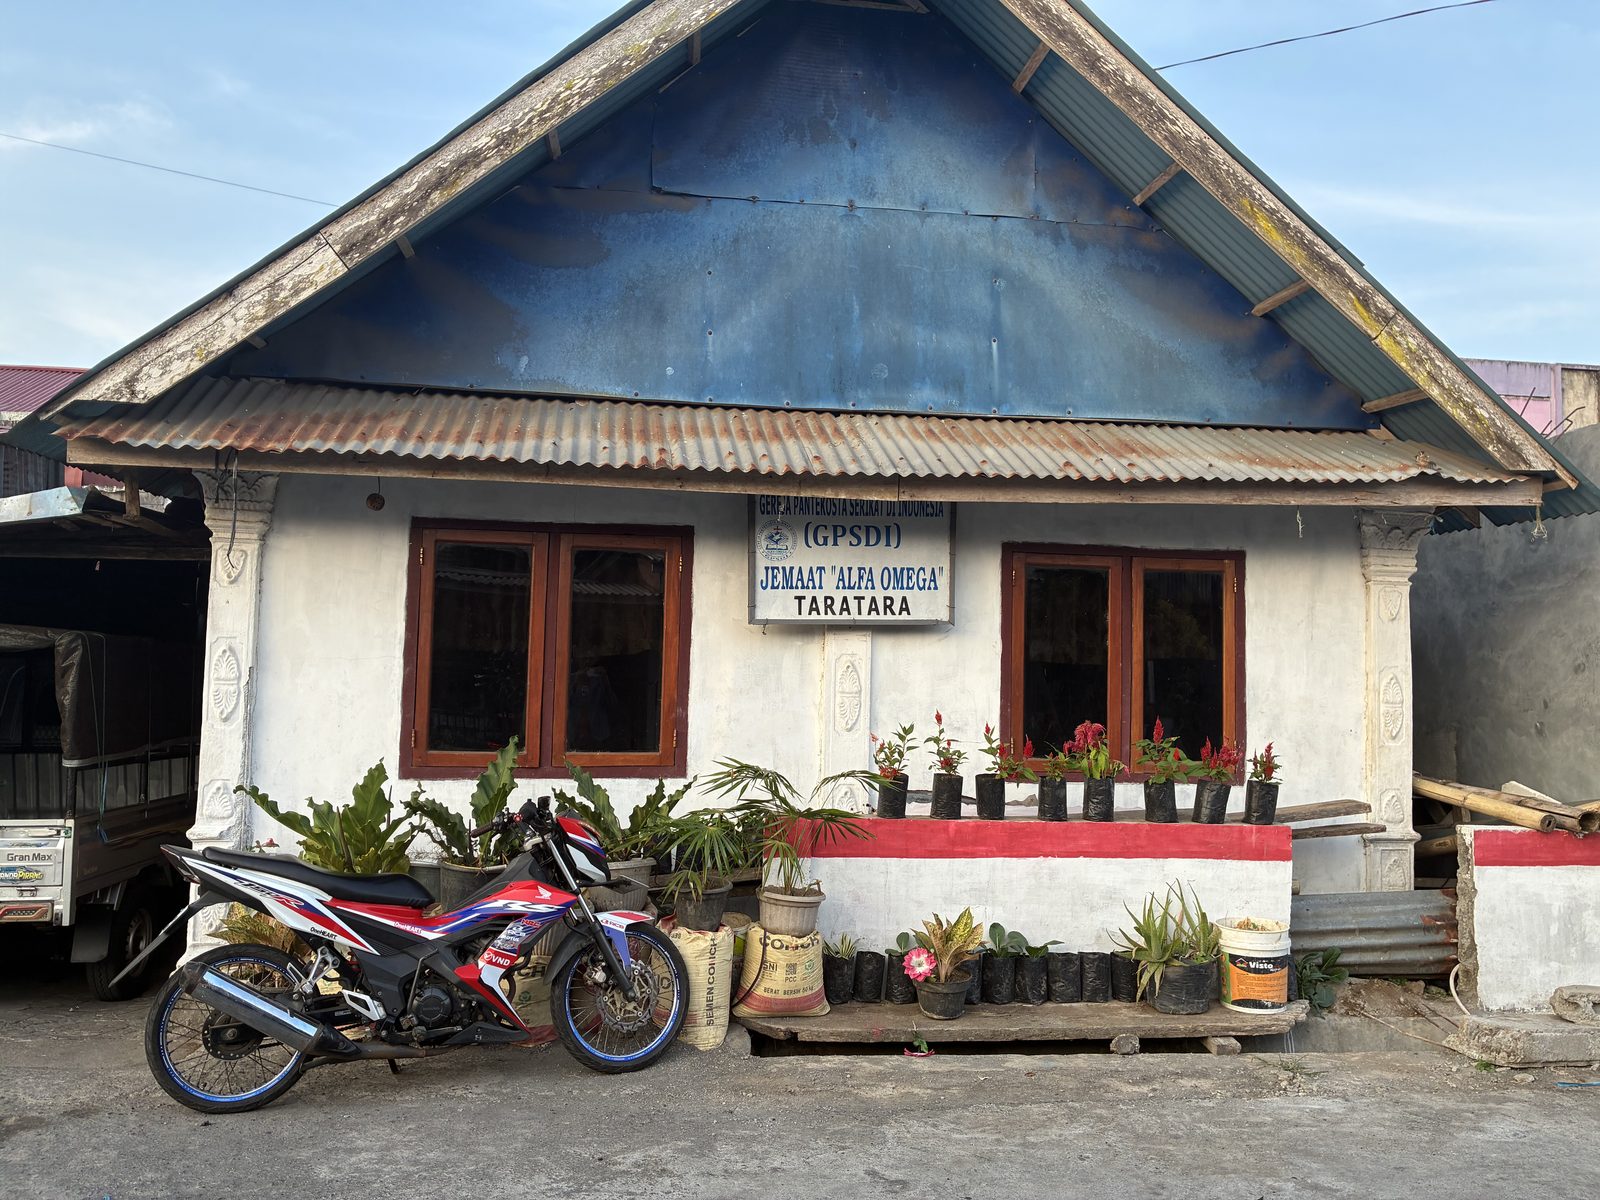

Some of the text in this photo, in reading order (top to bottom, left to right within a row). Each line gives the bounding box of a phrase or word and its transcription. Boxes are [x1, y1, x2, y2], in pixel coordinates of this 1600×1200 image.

[760, 495, 791, 515] GEREJA
[794, 496, 848, 516] PANTEKOSTA
[886, 501, 896, 517] DI
[898, 501, 944, 518] INDONESIA
[804, 522, 901, 549] (GPSDI)
[760, 565, 944, 591] JEMAAT "ALFA OMEGA"
[793, 595, 911, 616] TARATARA
[7, 852, 53, 862] Gran Max
[310, 926, 338, 940] OneHEART
[492, 955, 511, 966] VND
[1249, 961, 1274, 969] Visto
